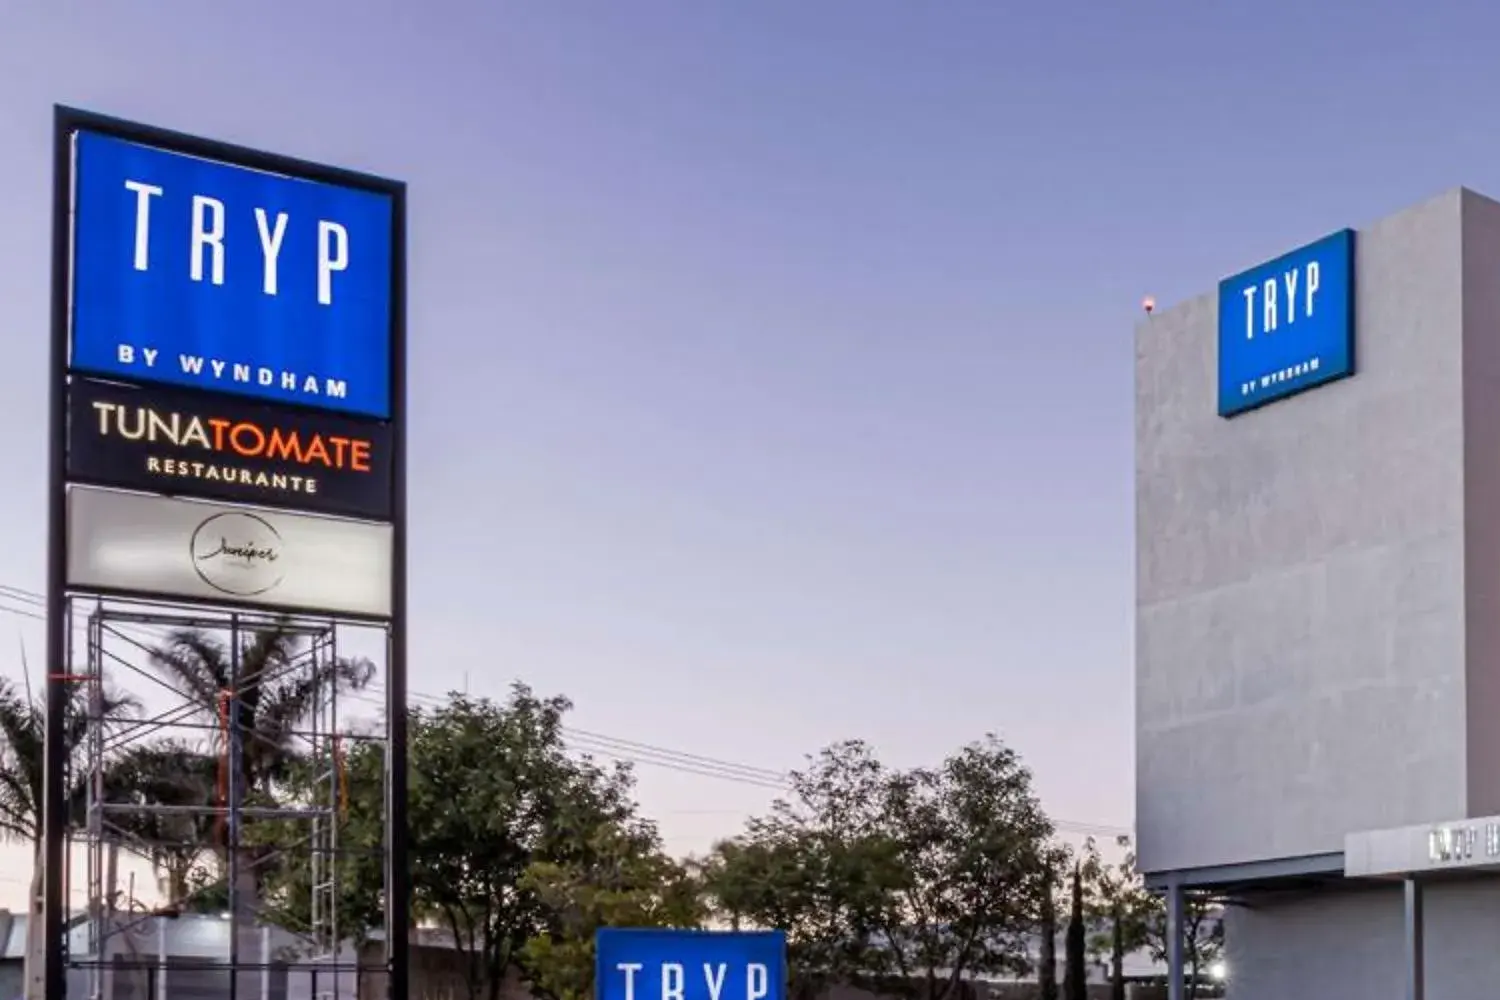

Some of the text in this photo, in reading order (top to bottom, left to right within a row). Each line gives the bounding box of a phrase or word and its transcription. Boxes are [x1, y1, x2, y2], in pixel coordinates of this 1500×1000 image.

[125, 180, 349, 305] TRYP
[1243, 261, 1319, 339] TRYP
[117, 344, 347, 399] BY WYNDHAM
[92, 401, 371, 473] TUNATOMATE
[147, 457, 318, 494] RESTAURANTE
